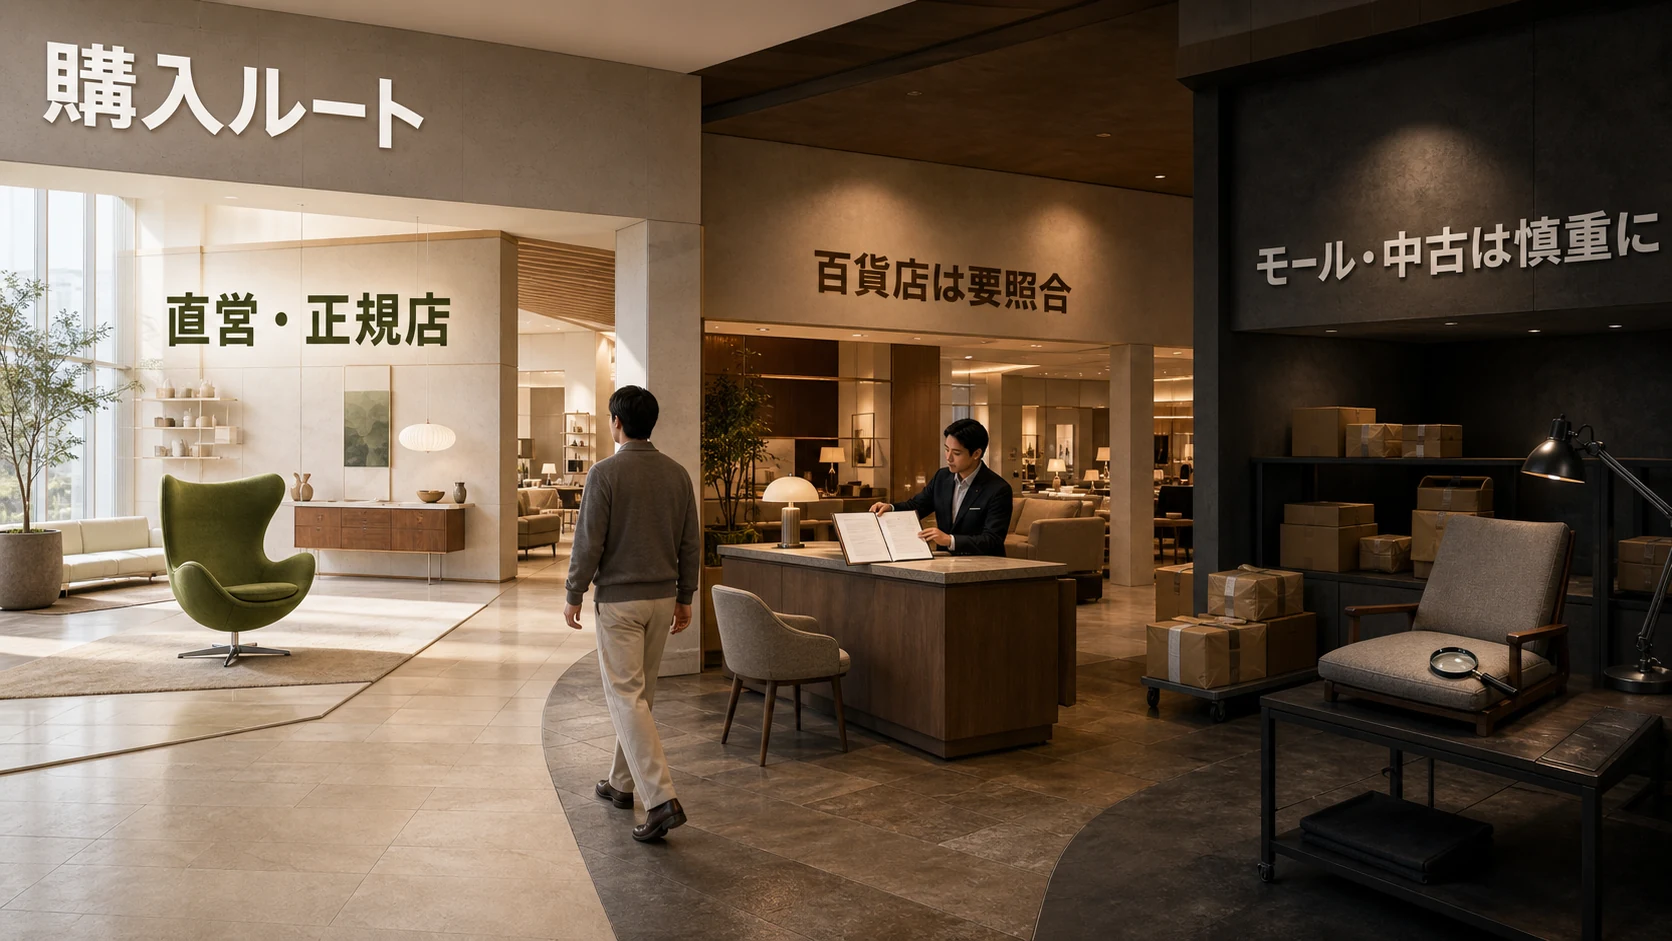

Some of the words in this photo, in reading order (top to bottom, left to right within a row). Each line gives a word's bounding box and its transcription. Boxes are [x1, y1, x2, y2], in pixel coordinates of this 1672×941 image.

[43, 41, 425, 149] 購入ルート
[814, 249, 1072, 314] 百貨店は要照合
[1256, 210, 1660, 286] モール・中古は慎重に
[166, 292, 451, 347] 直営・正規店
